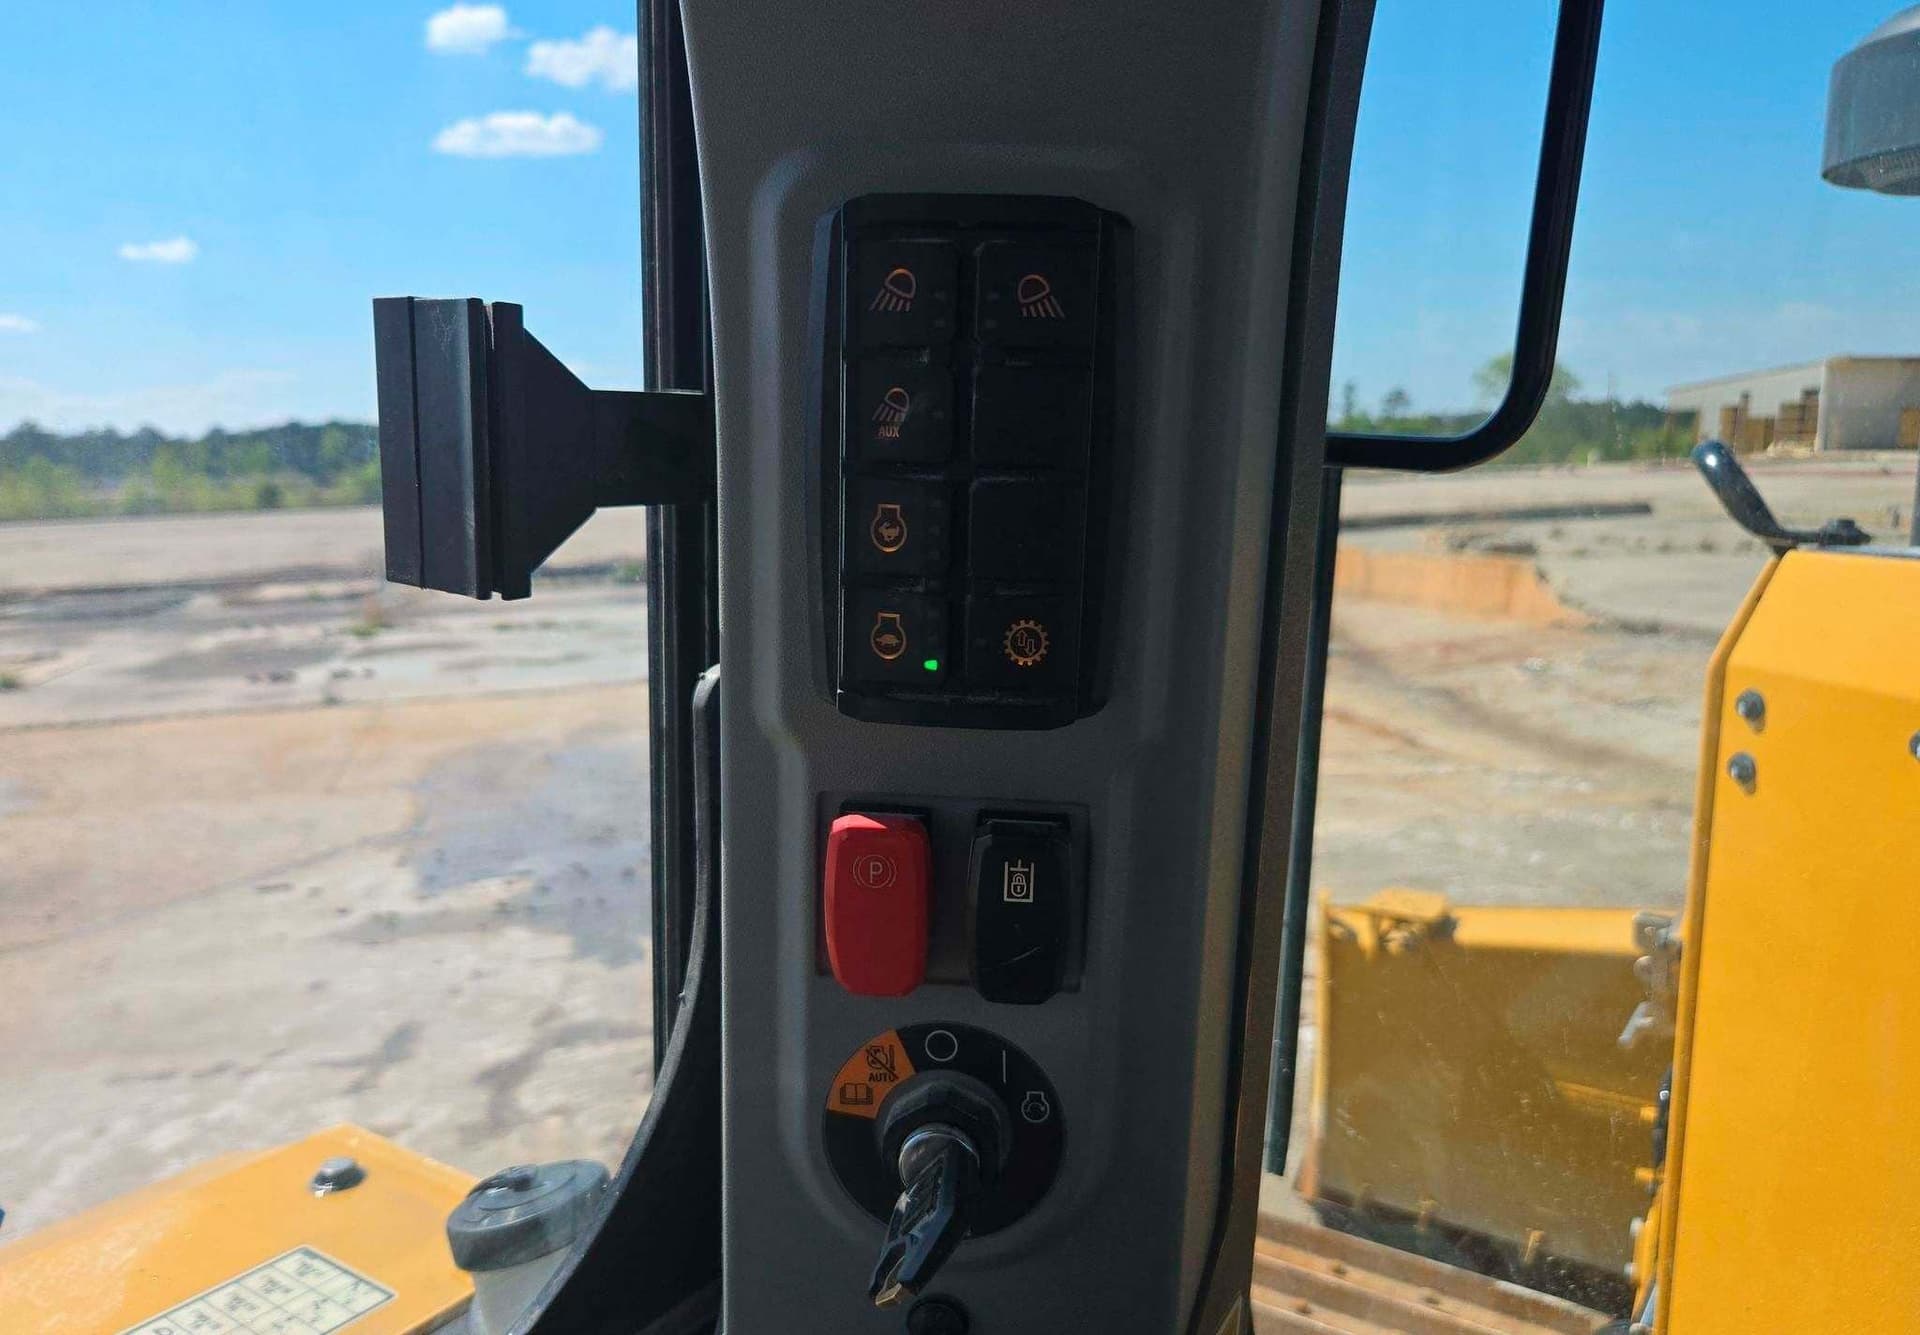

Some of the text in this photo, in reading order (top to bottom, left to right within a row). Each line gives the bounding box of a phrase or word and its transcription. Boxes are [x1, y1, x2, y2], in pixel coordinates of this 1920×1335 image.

[879, 425, 900, 438] AUX
[870, 861, 883, 884] P
[868, 1072, 896, 1082] AUTO
